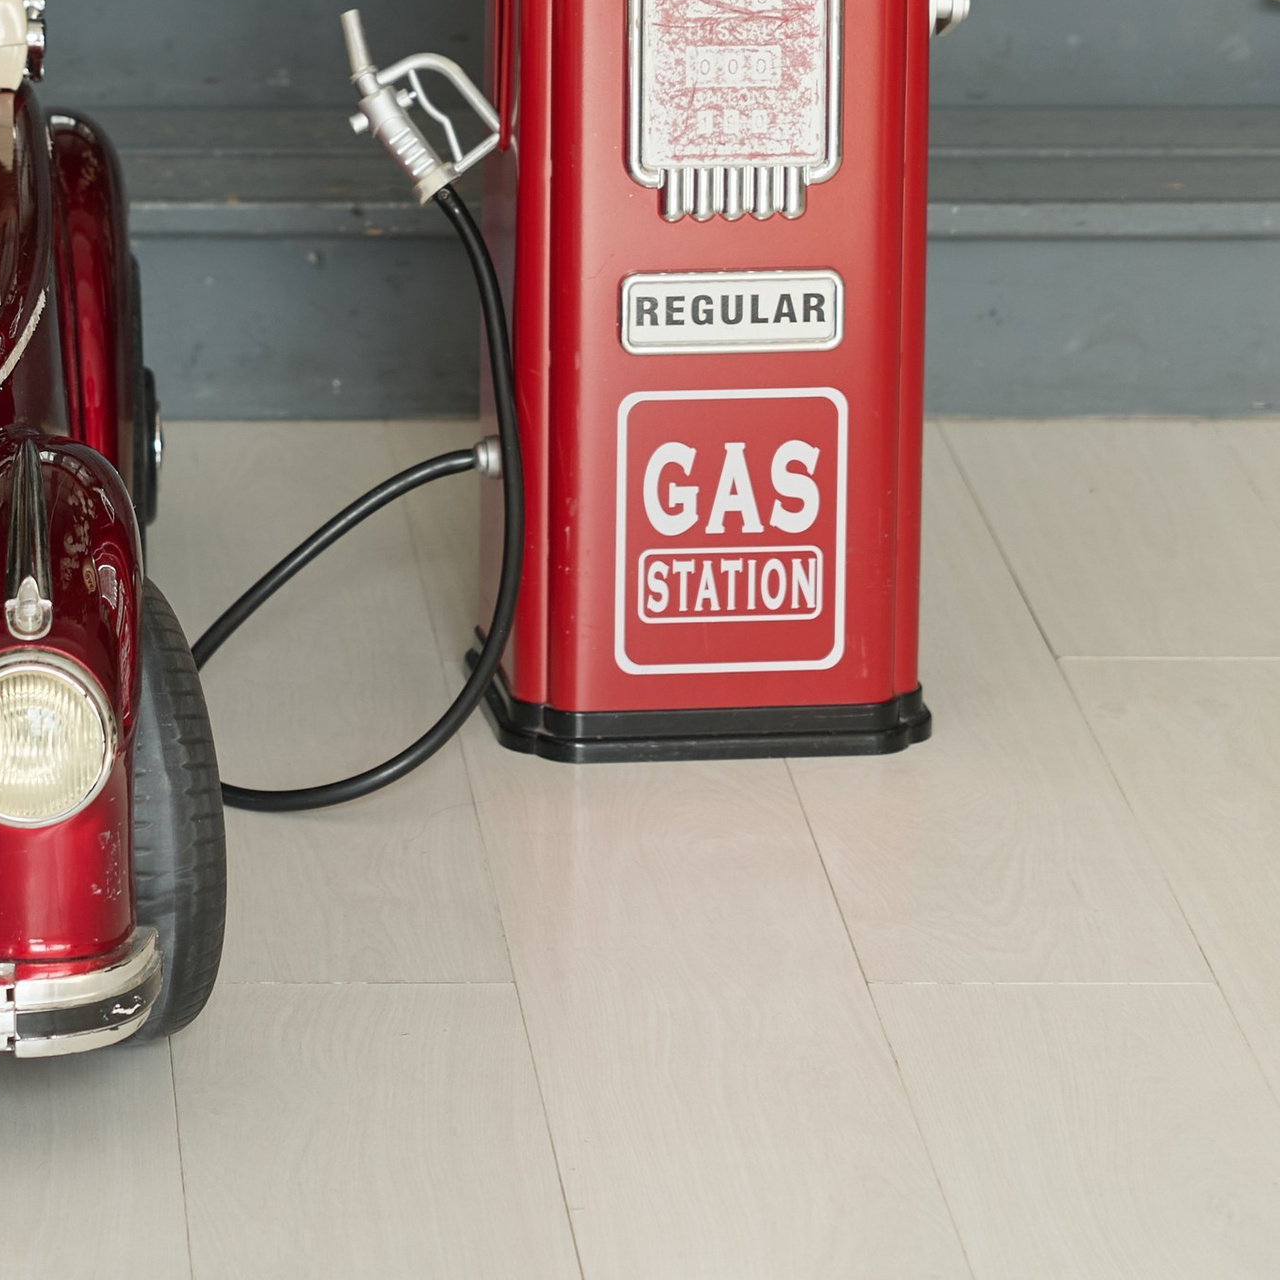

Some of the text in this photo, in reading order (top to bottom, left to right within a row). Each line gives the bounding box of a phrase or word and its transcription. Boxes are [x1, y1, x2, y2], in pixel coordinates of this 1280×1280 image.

[635, 292, 826, 326] REGULAR
[642, 440, 820, 536] GAS
[646, 557, 817, 613] STATION
